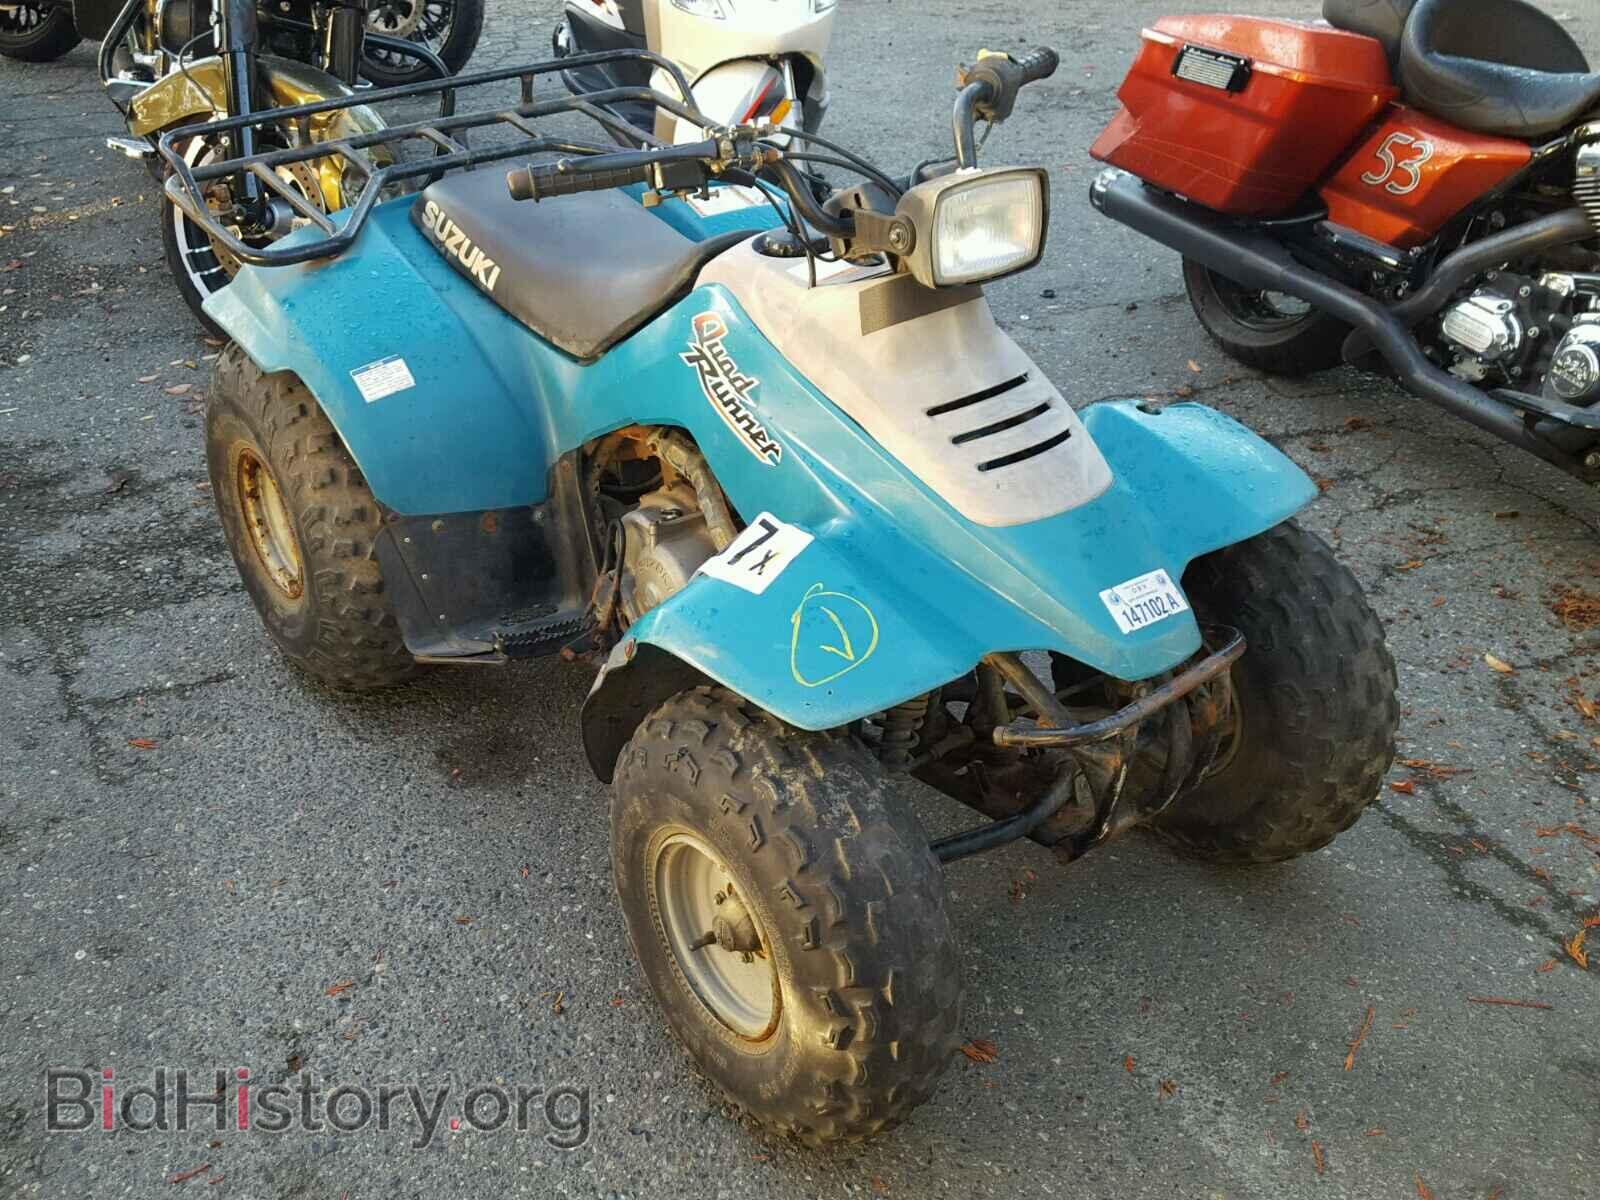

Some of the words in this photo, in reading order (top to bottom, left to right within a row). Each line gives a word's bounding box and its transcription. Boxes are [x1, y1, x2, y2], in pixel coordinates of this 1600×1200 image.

[1361, 131, 1434, 195] 53
[421, 200, 501, 291] SUZUKI
[681, 345, 781, 462] Runner
[1121, 595, 1169, 628] 147102
